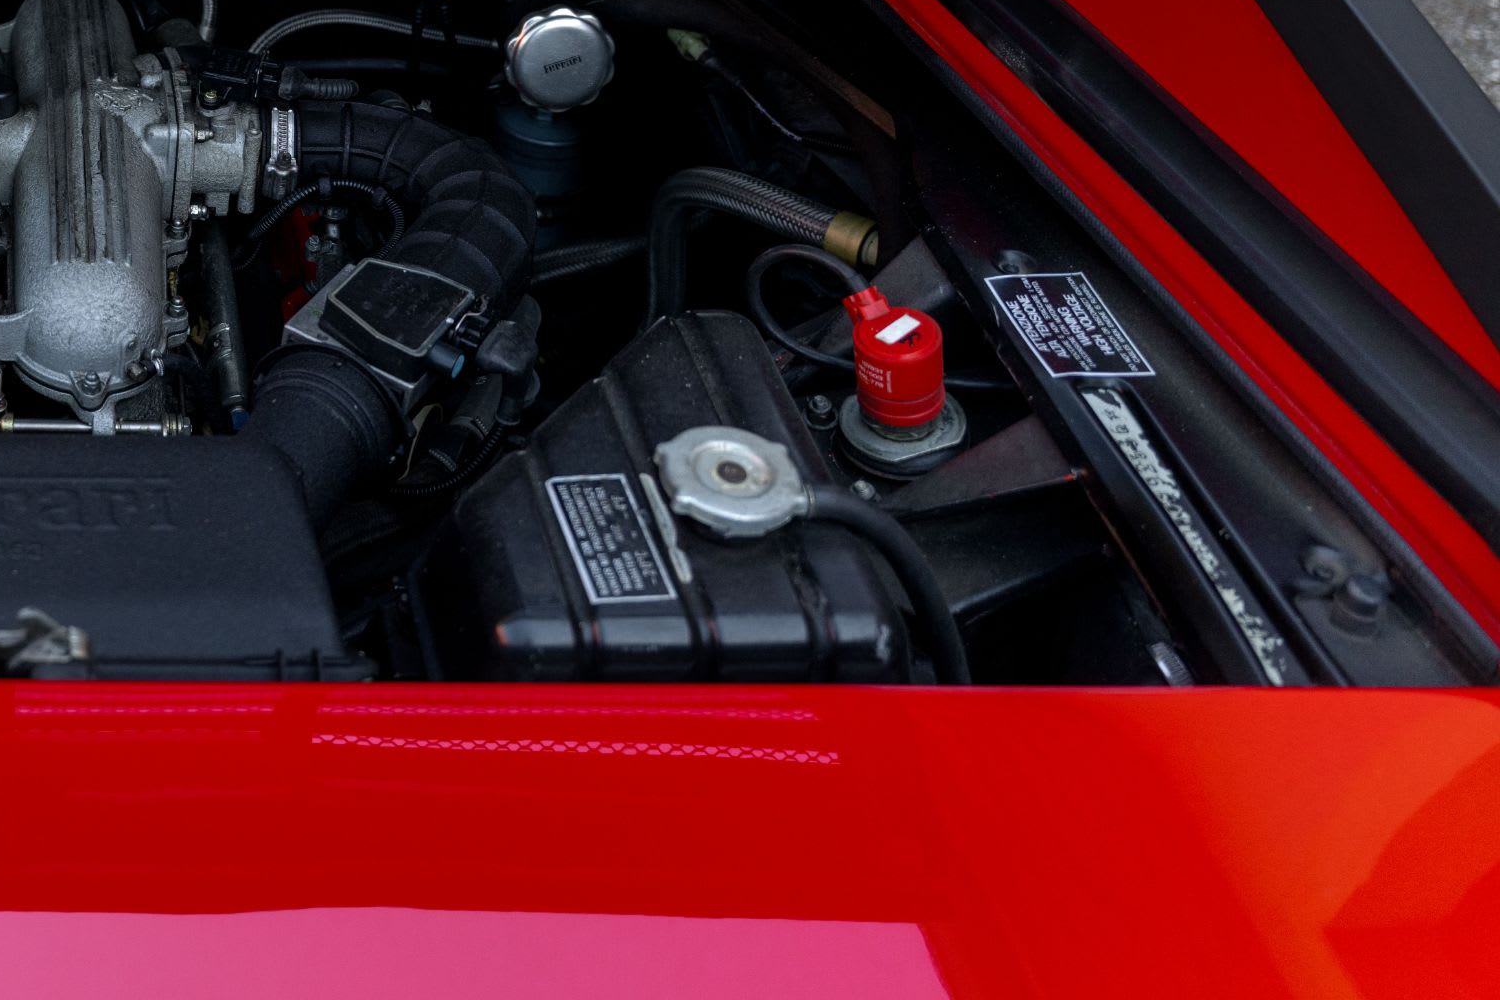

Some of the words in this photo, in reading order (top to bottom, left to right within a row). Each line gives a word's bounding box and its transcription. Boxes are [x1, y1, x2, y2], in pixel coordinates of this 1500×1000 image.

[543, 55, 582, 73] Ferrari
[1005, 301, 1050, 351] ATTENZIONE
[1014, 294, 1055, 336] TENSIONE
[1056, 307, 1093, 345] WARNING
[1062, 294, 1097, 330] VOLTAGE
[1080, 297, 1104, 325] DISCONNECT
[1046, 339, 1070, 358] ALTA
[1091, 334, 1115, 355] HIGH
